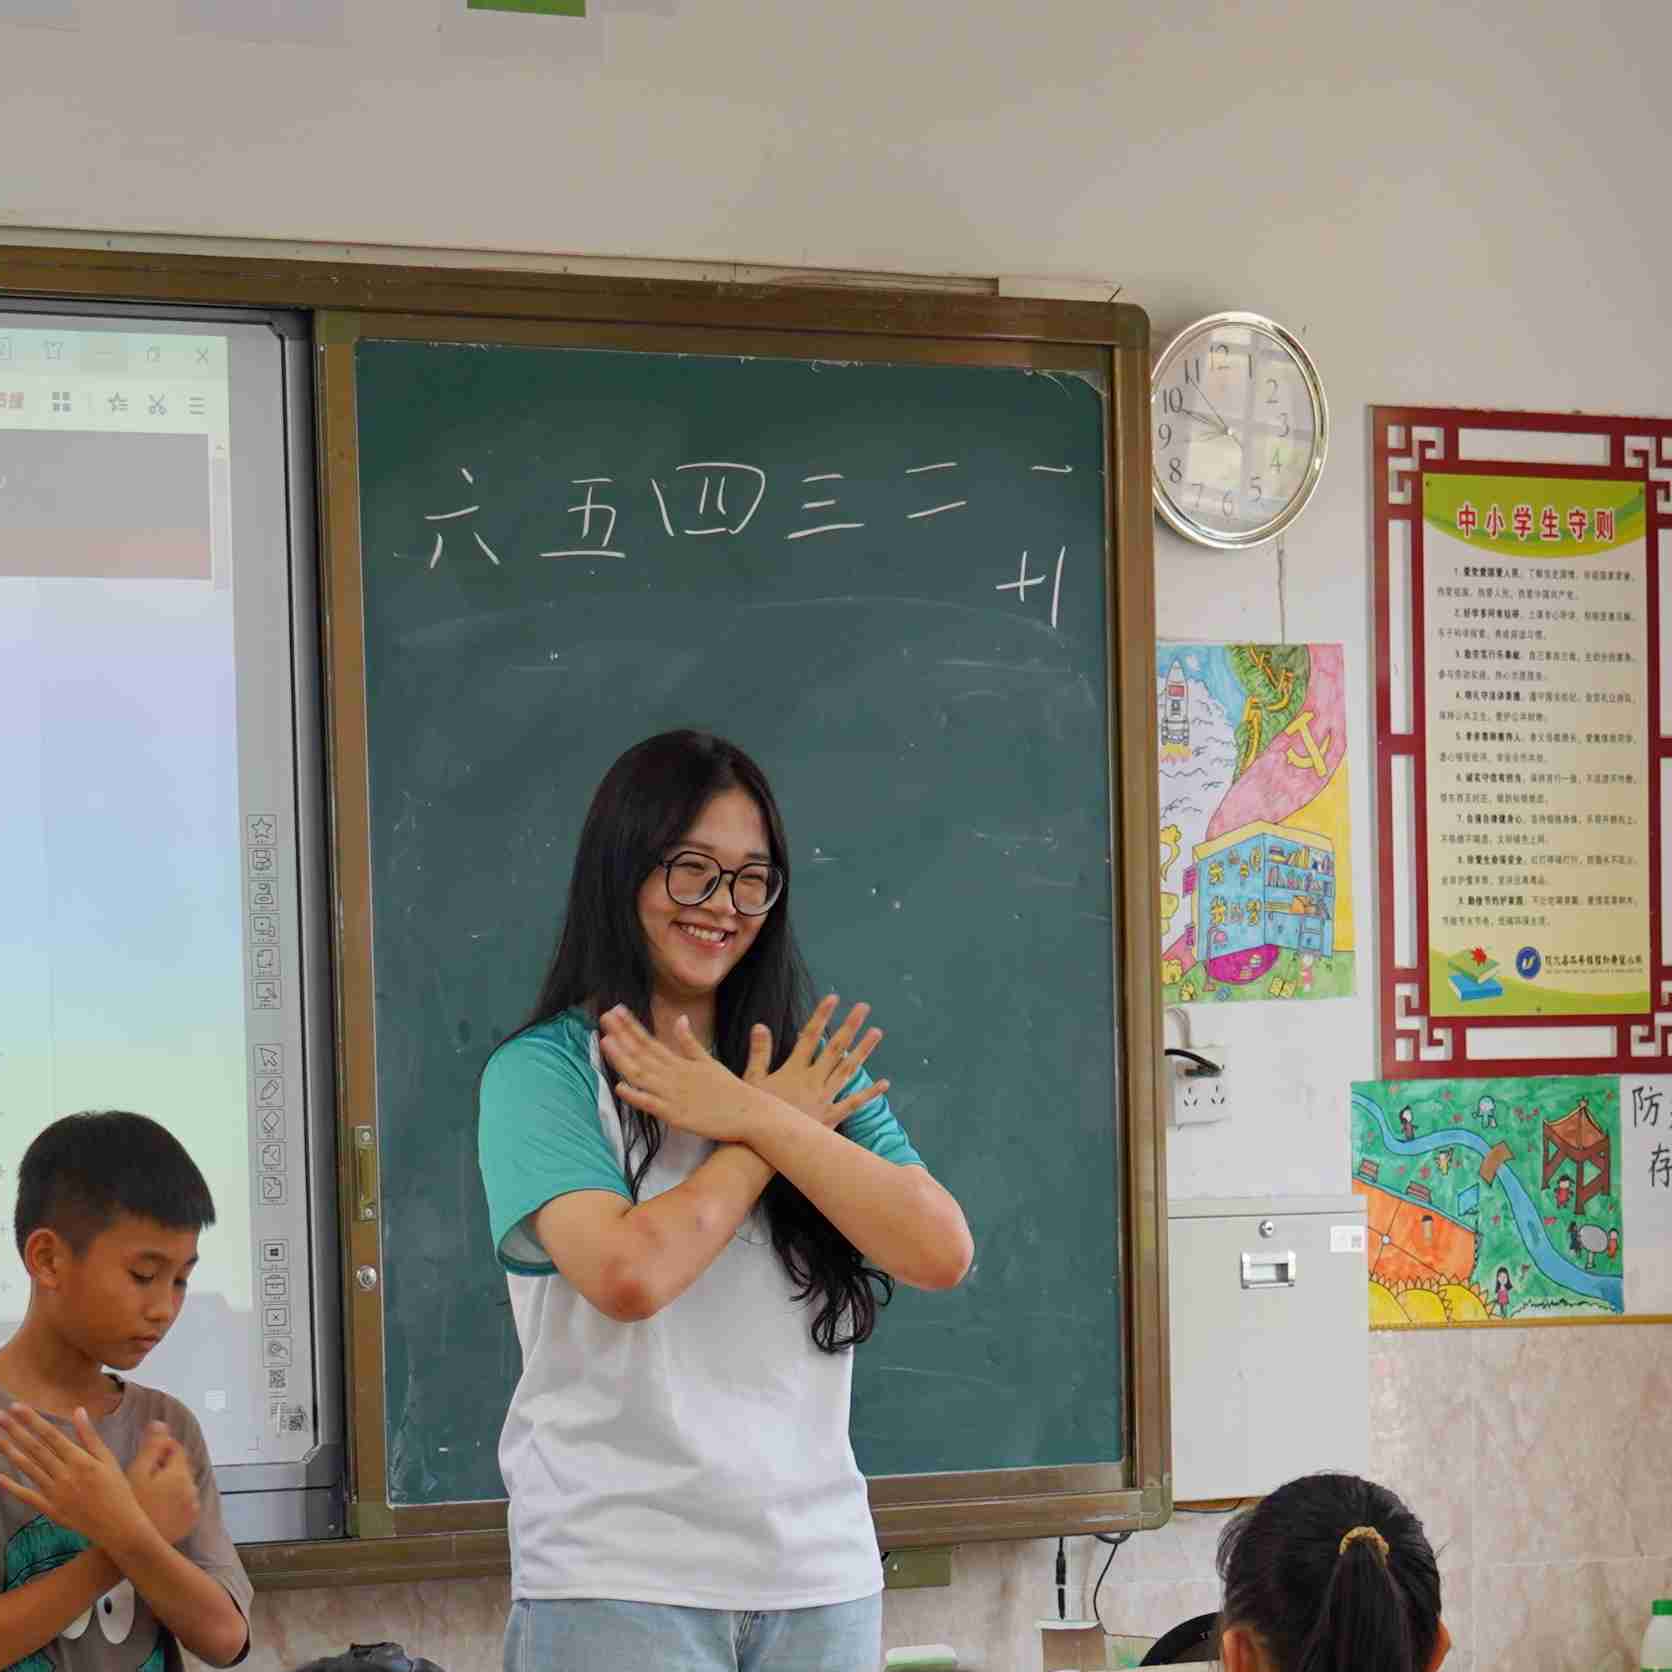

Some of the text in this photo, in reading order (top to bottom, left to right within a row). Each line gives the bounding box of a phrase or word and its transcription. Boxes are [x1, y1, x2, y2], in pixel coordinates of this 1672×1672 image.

[1184, 358, 1201, 384] 11
[1209, 344, 1231, 372] 12
[1162, 387, 1184, 415] 10
[1264, 379, 1280, 405] 2
[1158, 423, 1174, 450] 9
[1278, 413, 1291, 438] 3
[1169, 456, 1184, 484] 8
[1191, 482, 1205, 509] 7
[1249, 476, 1264, 503] 5
[424, 468, 501, 569] 六
[540, 477, 627, 559] 五
[650, 461, 766, 538] 四
[787, 473, 866, 540] 三
[904, 461, 968, 521] 二
[1221, 490, 1235, 518] 6
[1456, 503, 1619, 544] 中小学生守则
